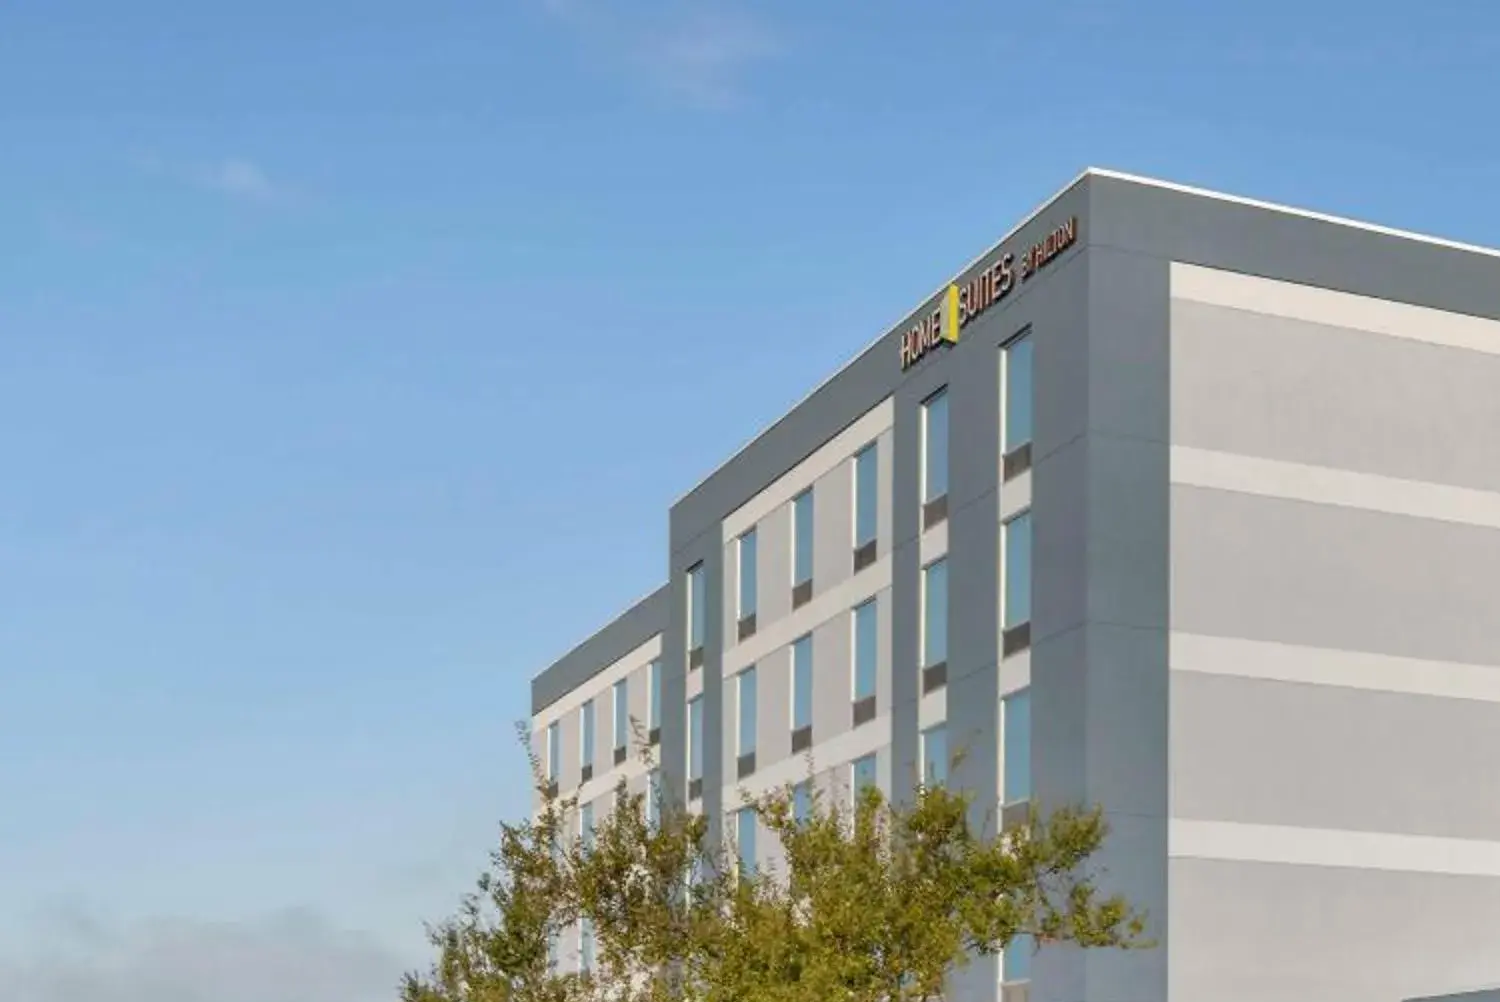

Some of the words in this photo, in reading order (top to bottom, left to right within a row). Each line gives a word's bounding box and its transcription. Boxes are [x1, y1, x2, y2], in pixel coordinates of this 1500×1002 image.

[900, 306, 942, 369] HOME
[959, 252, 1014, 327] SUITES
[1034, 216, 1077, 268] HILTON
